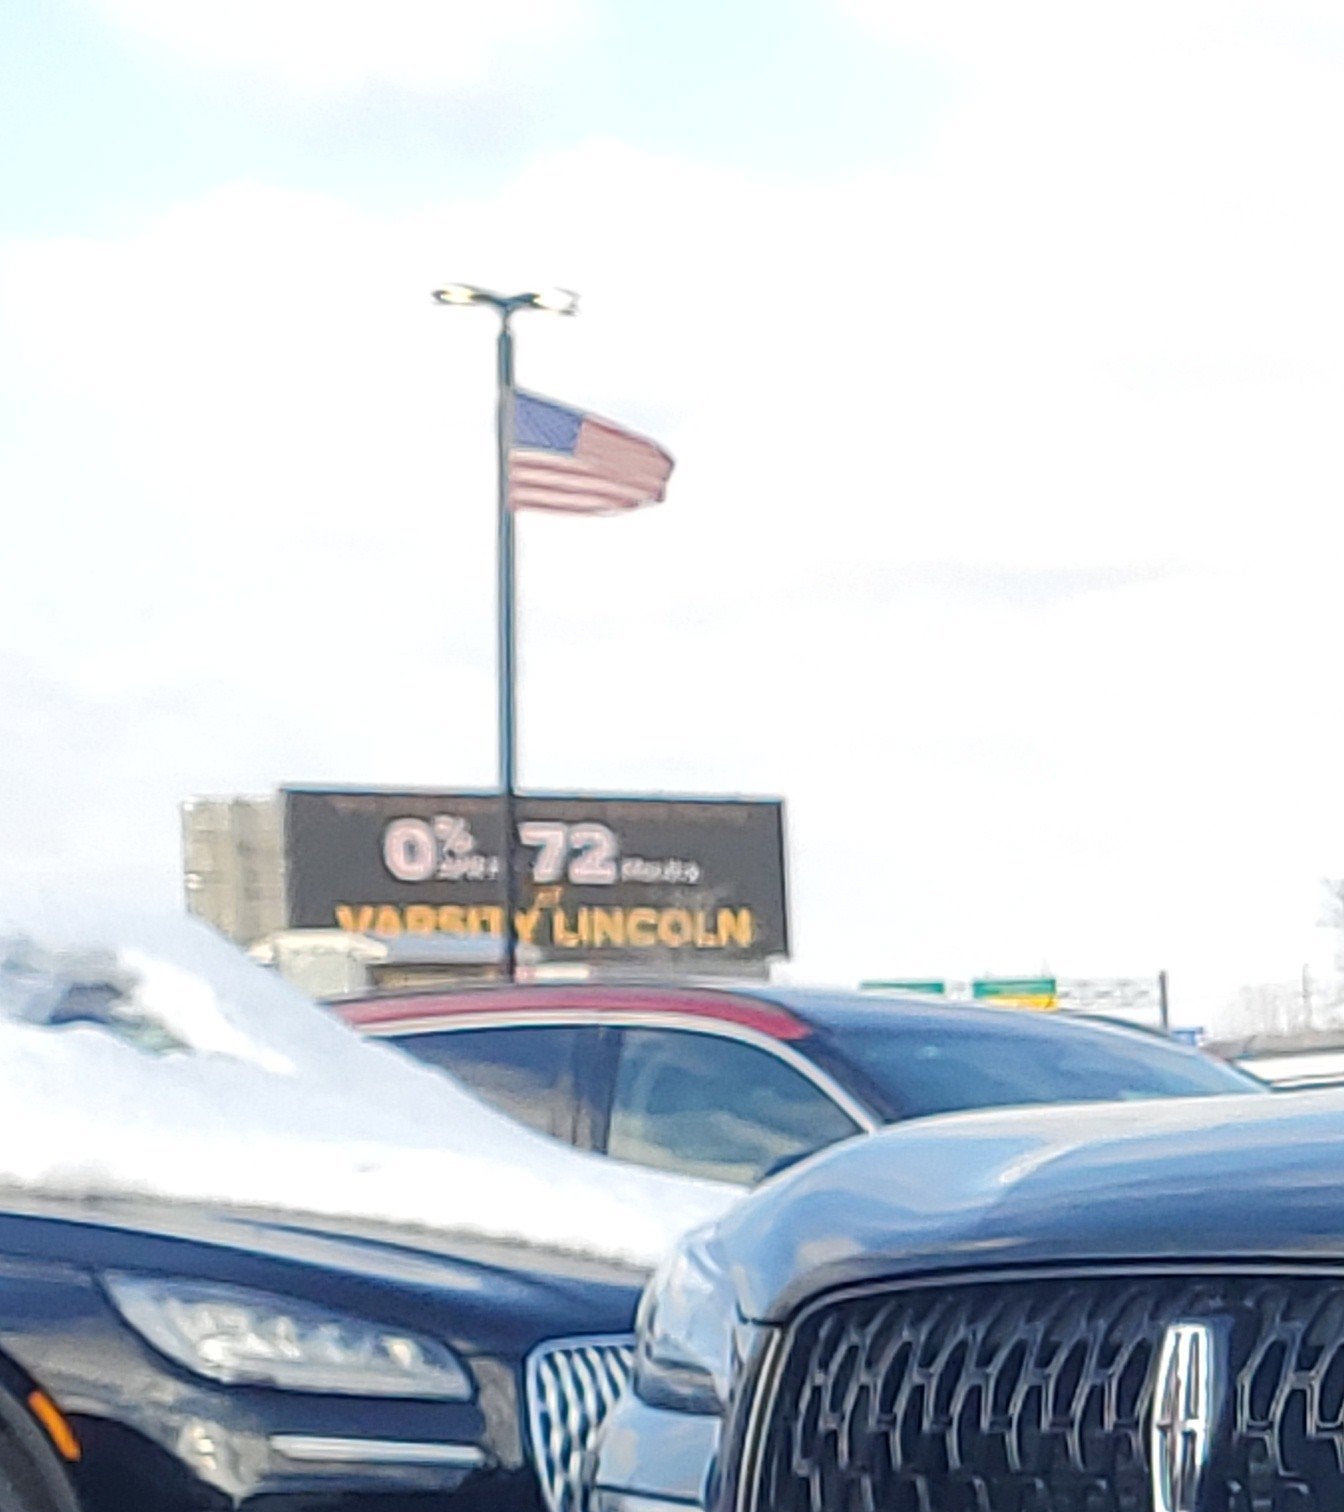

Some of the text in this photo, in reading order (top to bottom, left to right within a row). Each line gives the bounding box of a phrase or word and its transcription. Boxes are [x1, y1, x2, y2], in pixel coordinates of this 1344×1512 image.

[384, 814, 619, 884] 0% 72
[552, 906, 753, 948] LINCOLN
